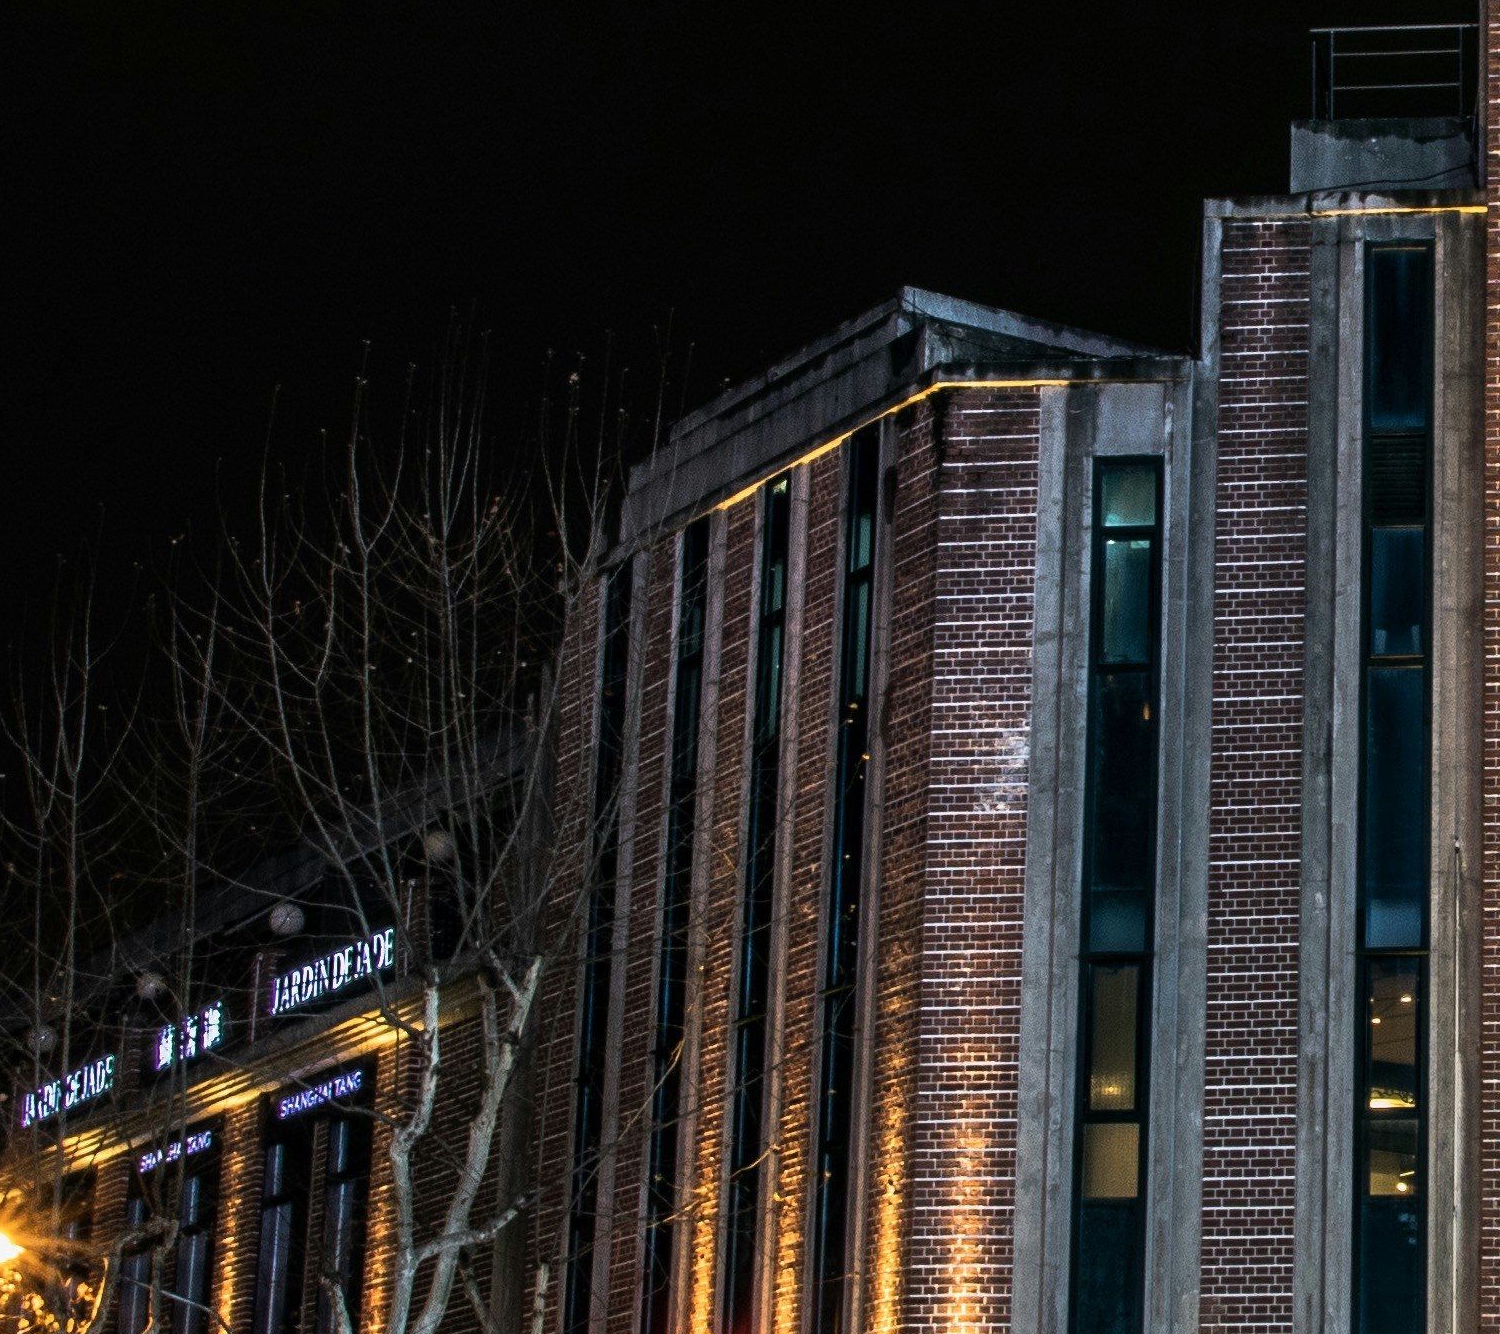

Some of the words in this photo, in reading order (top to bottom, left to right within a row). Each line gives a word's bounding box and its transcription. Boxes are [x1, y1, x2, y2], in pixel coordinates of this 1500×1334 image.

[270, 956, 331, 1015] JARDIN
[279, 1080, 332, 1119] SHANGHAI
[334, 1070, 363, 1097] TANG
